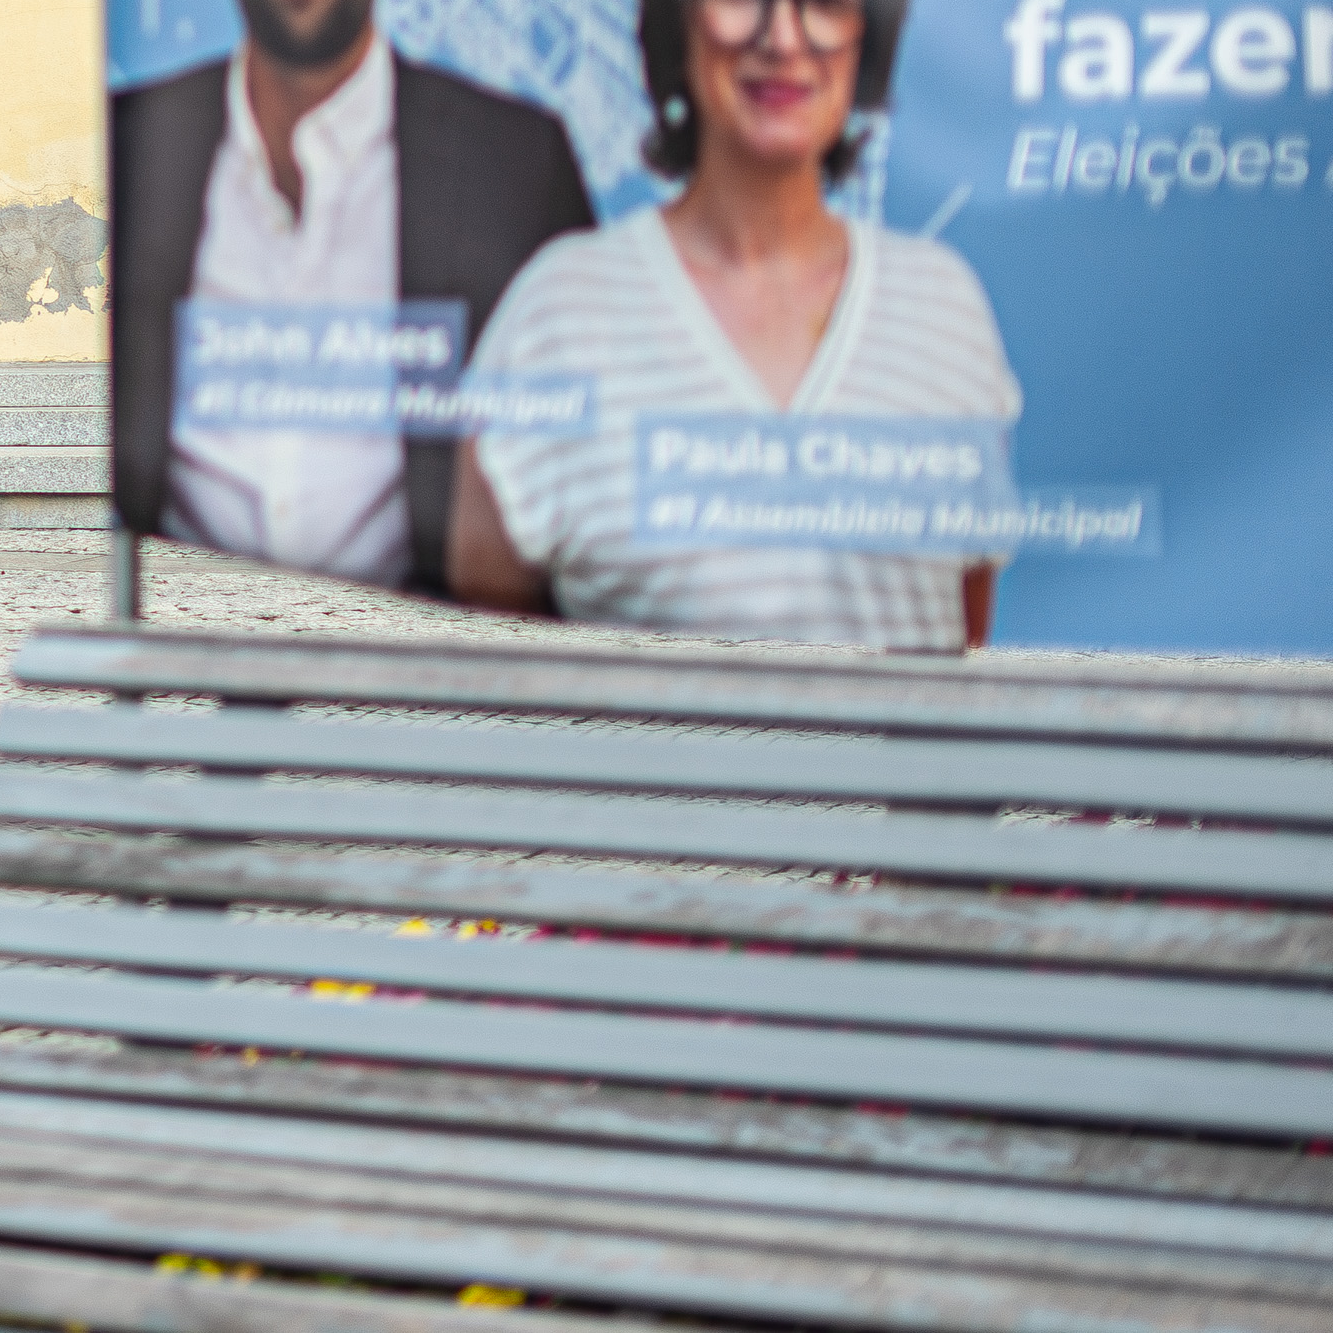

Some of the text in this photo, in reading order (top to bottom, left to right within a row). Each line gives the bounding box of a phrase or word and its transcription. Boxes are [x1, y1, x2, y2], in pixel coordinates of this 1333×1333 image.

[1007, 120, 1311, 208] Eleições
[649, 429, 985, 482] Paula Chaves
[934, 497, 1145, 546] Municipal
